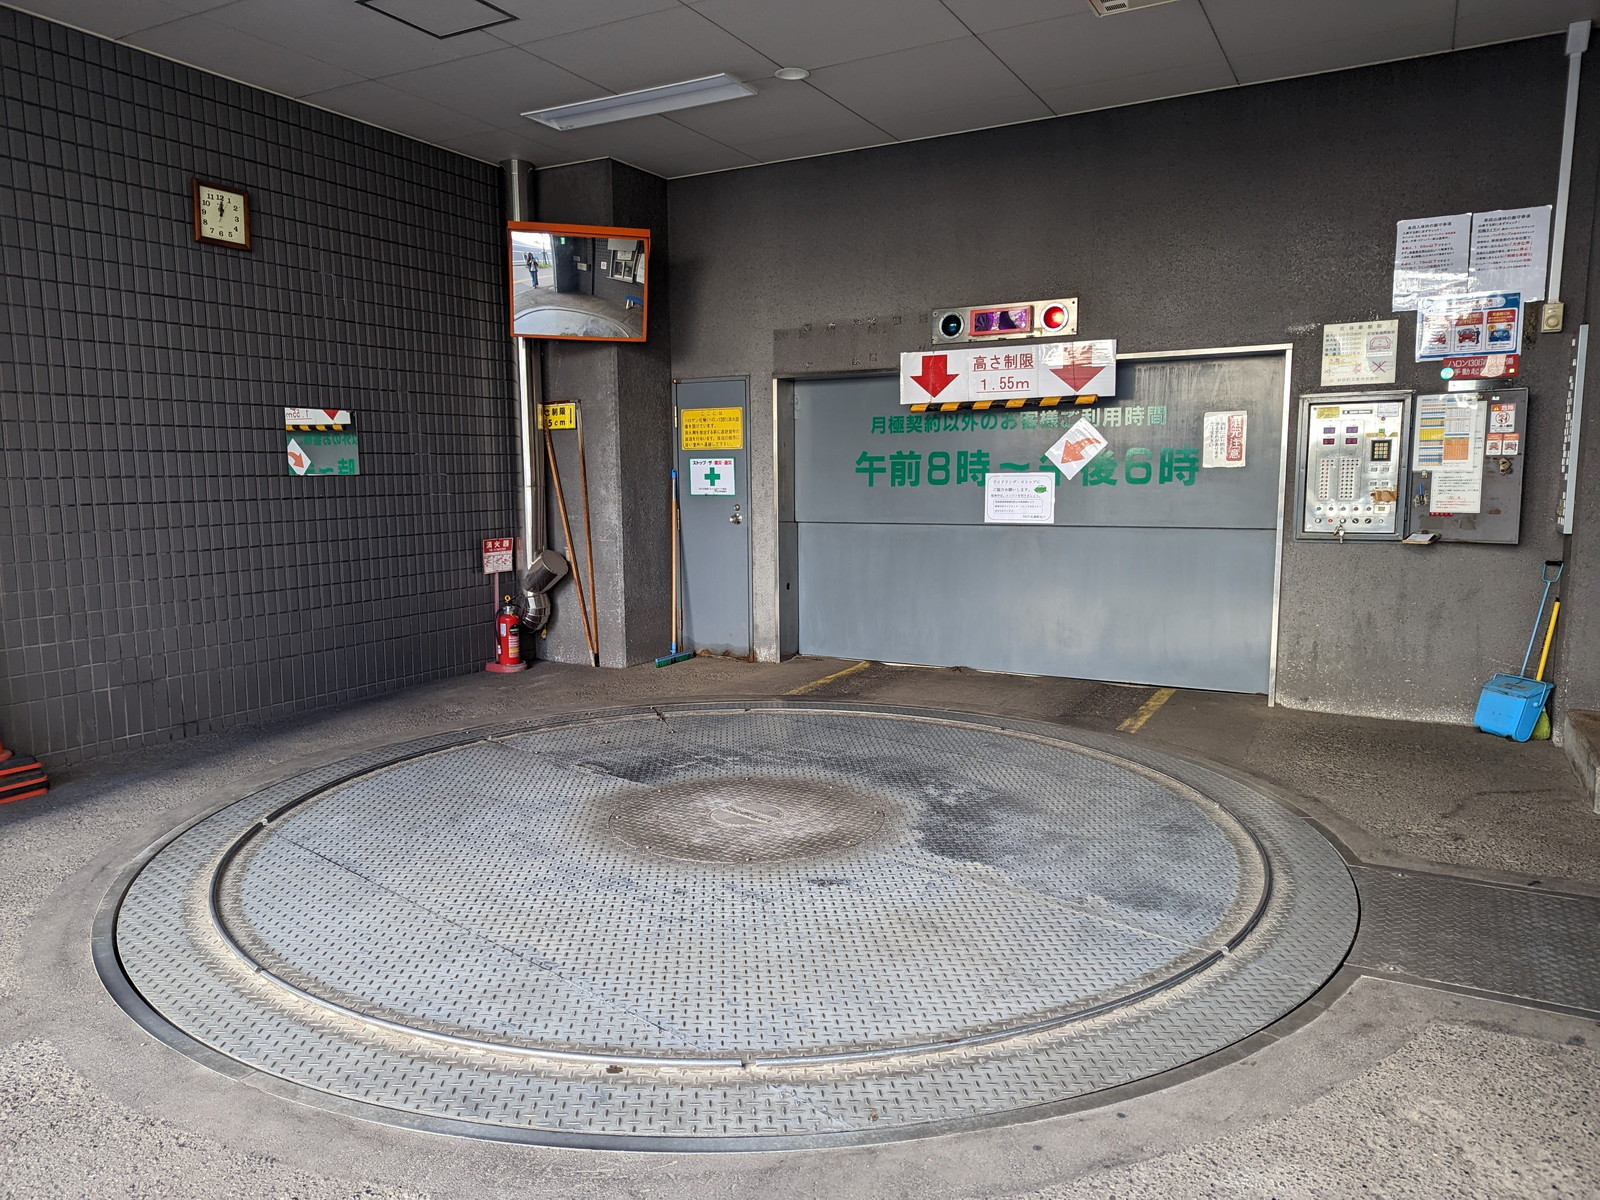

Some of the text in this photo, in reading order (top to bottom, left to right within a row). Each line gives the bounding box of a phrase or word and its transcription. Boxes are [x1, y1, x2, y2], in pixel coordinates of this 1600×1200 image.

[216, 194, 224, 202] 12
[973, 353, 1034, 370] 高さ制限
[980, 377, 1030, 391] 1.55m
